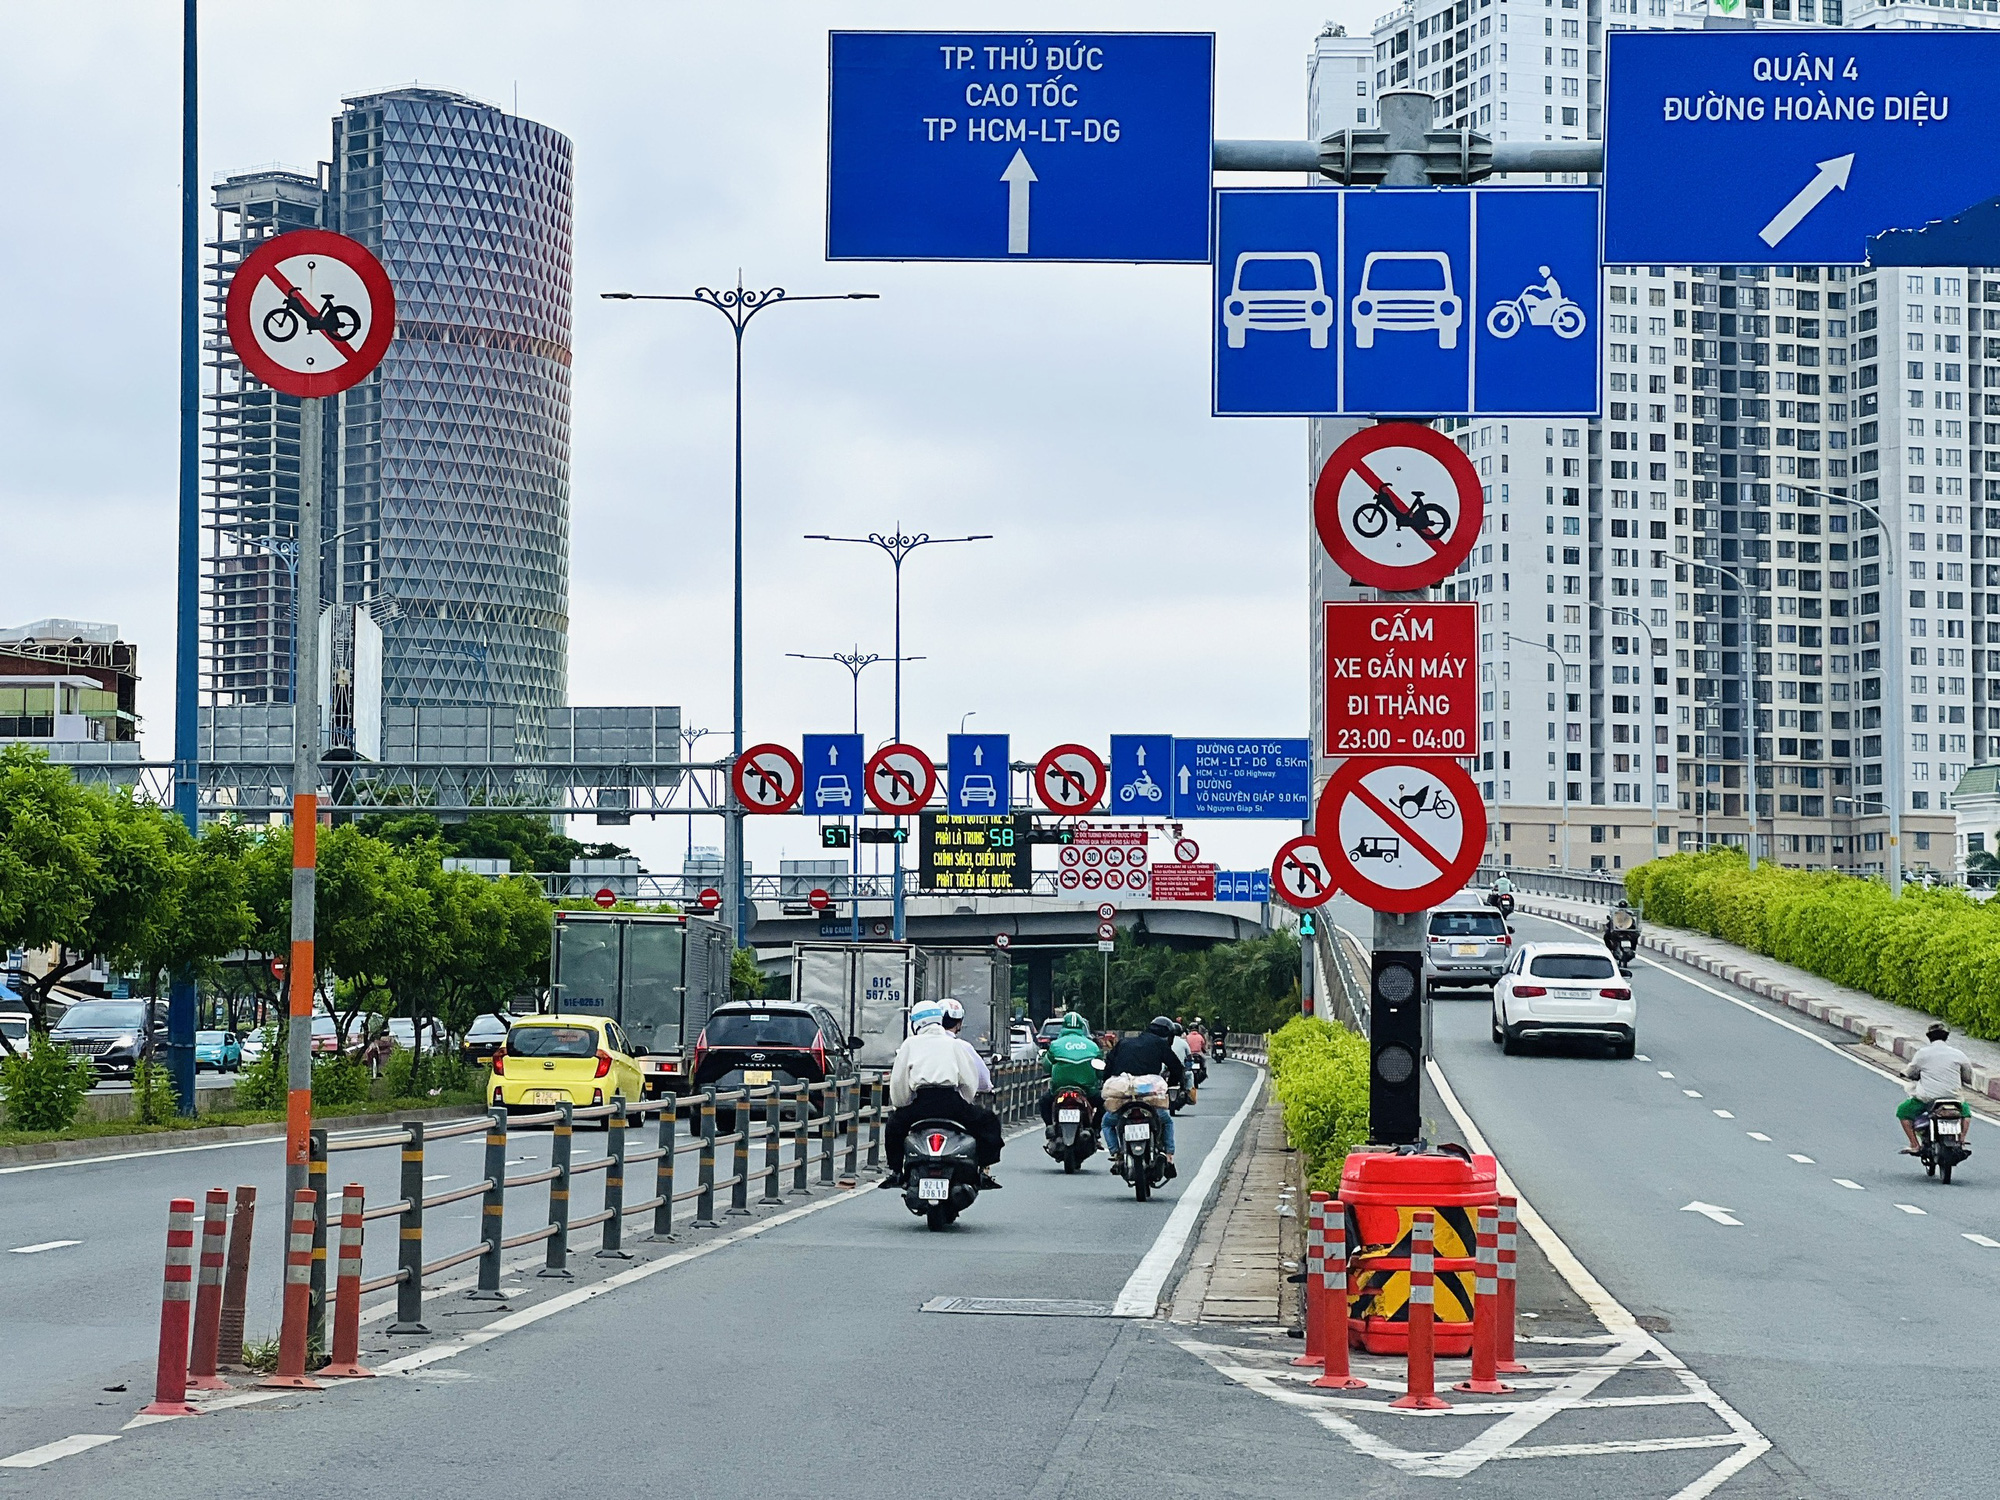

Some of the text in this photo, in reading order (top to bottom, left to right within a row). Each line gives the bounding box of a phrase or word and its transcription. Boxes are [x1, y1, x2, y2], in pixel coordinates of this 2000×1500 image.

[940, 38, 1103, 71] TP. THỦ ĐỨC
[1753, 52, 1859, 87] QUẬN 4
[965, 74, 1079, 107] CAO TỐC
[1663, 90, 1949, 127] ĐƯỜNG HOÀNG DIỆU
[923, 118, 1121, 143] TP HCM-LT-DG
[1370, 608, 1434, 642] CẤM
[1334, 647, 1467, 679] XE GẮN MÁY
[1347, 683, 1450, 716] ĐI THẲNG
[1196, 741, 1282, 754] ĐƯỜNG CAO TỐC
[1337, 728, 1391, 750] 23:00
[1412, 728, 1466, 750] 04:00
[1196, 757, 1219, 767] HCM
[1230, 757, 1242, 767] LT
[1252, 757, 1267, 767] DG
[1275, 757, 1308, 768] 6.5Km
[1196, 778, 1232, 789] ĐƯỜNG
[1196, 792, 1209, 802] VÕ
[1252, 790, 1275, 802] GIÁP
[1278, 793, 1291, 802] 9.0
[1292, 793, 1307, 802] Km
[1196, 804, 1205, 812] Vo
[1207, 804, 1235, 813] Nguyen
[1236, 804, 1253, 813] Giap
[825, 828, 847, 844] 57
[935, 827, 985, 845] PHẢI LÀ TRUNG
[989, 828, 1014, 847] 58
[933, 847, 1016, 868] CHÍNH SÁCH, CHIẾN LƯỢC
[936, 868, 1013, 888] PHÁT TRIỂN ĐẤT NƯỚC.
[1102, 907, 1112, 916] 60
[872, 977, 892, 989] 61C
[1065, 1041, 1087, 1051] Grab
